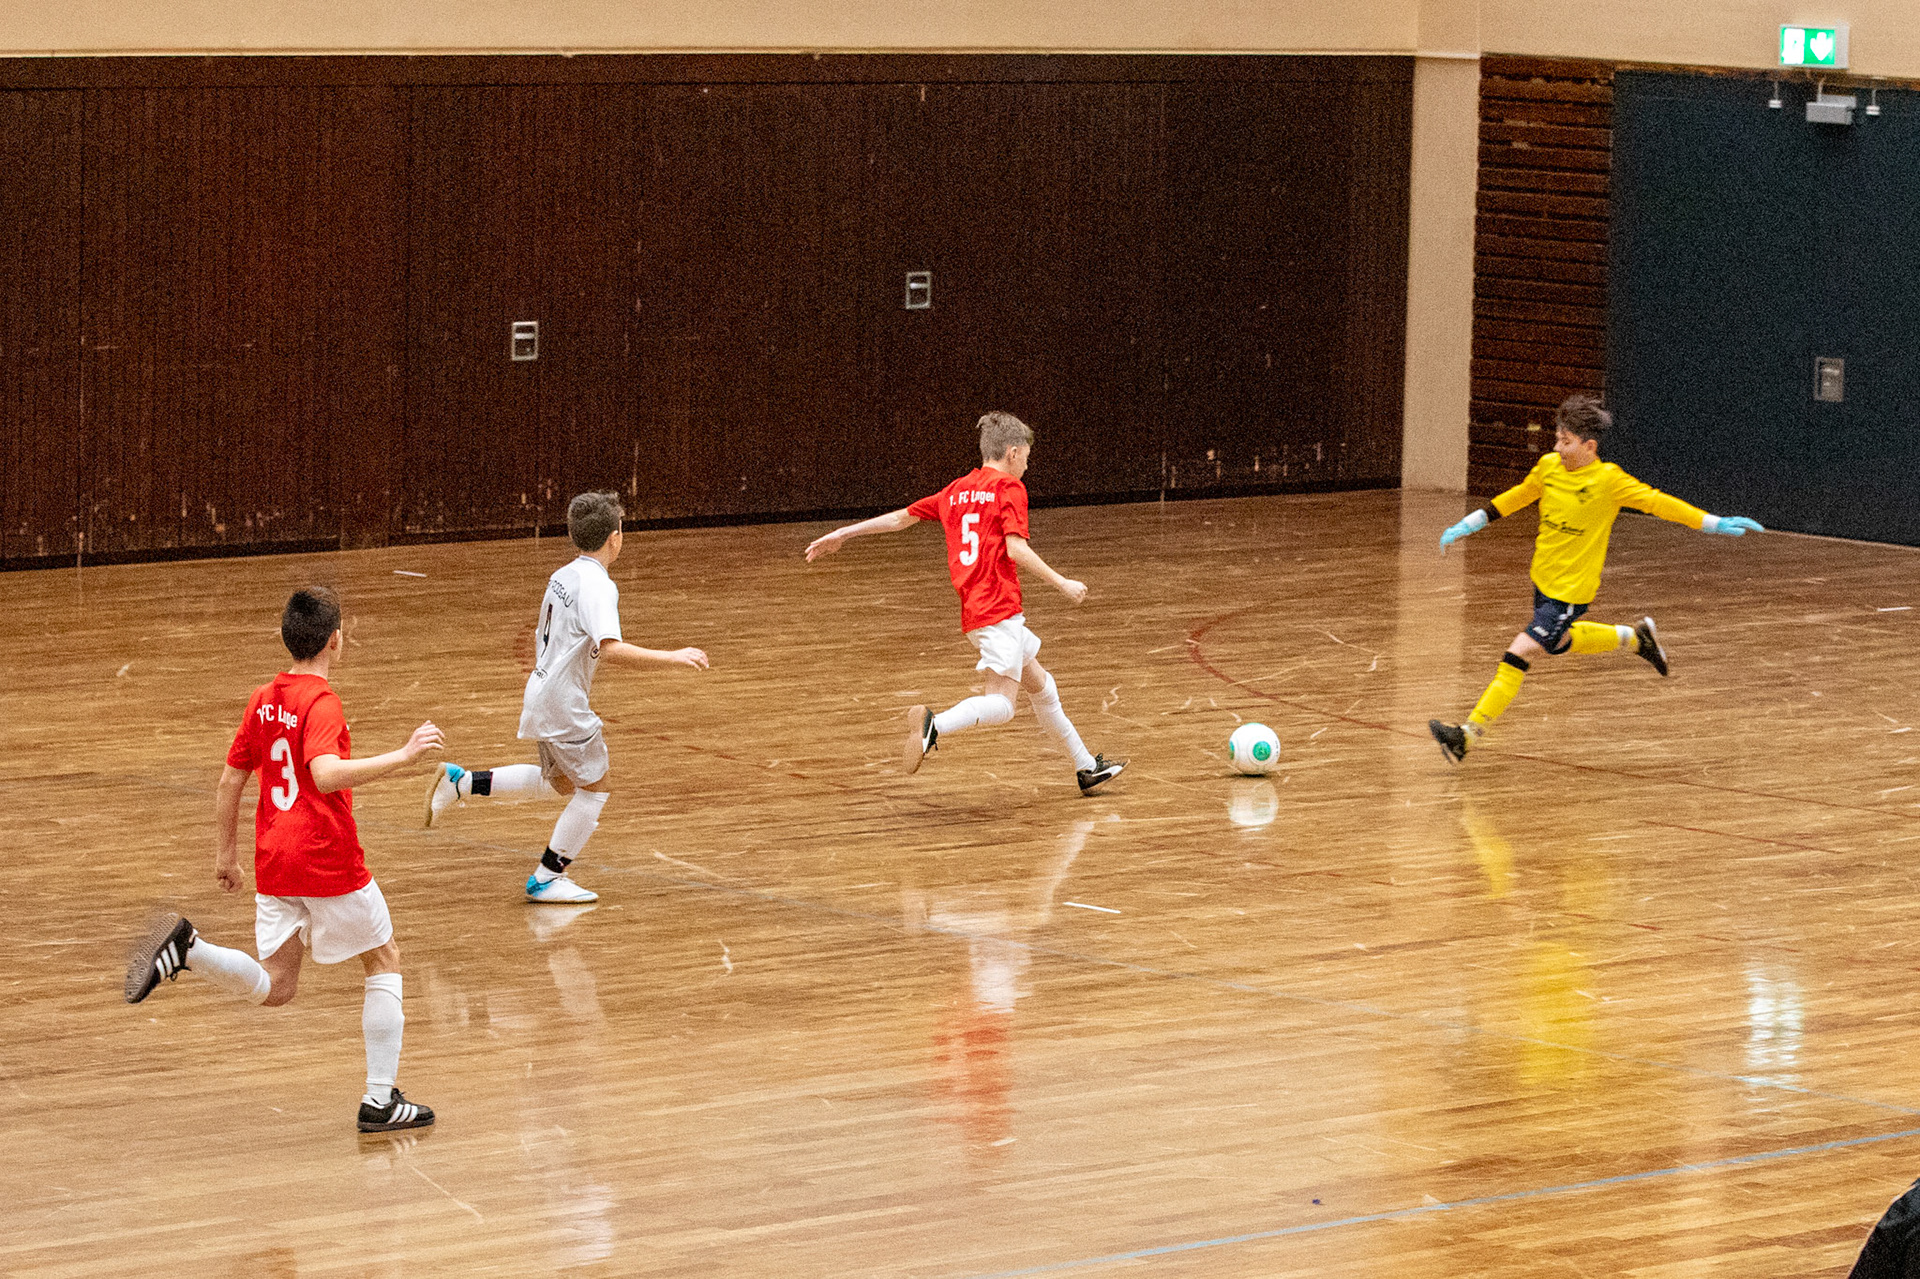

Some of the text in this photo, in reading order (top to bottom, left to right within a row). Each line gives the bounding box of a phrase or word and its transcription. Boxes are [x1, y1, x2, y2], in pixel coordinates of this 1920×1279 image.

[949, 495, 957, 507] 1.
[958, 490, 970, 505] FC
[959, 513, 980, 566] 5
[270, 737, 299, 811] 3
